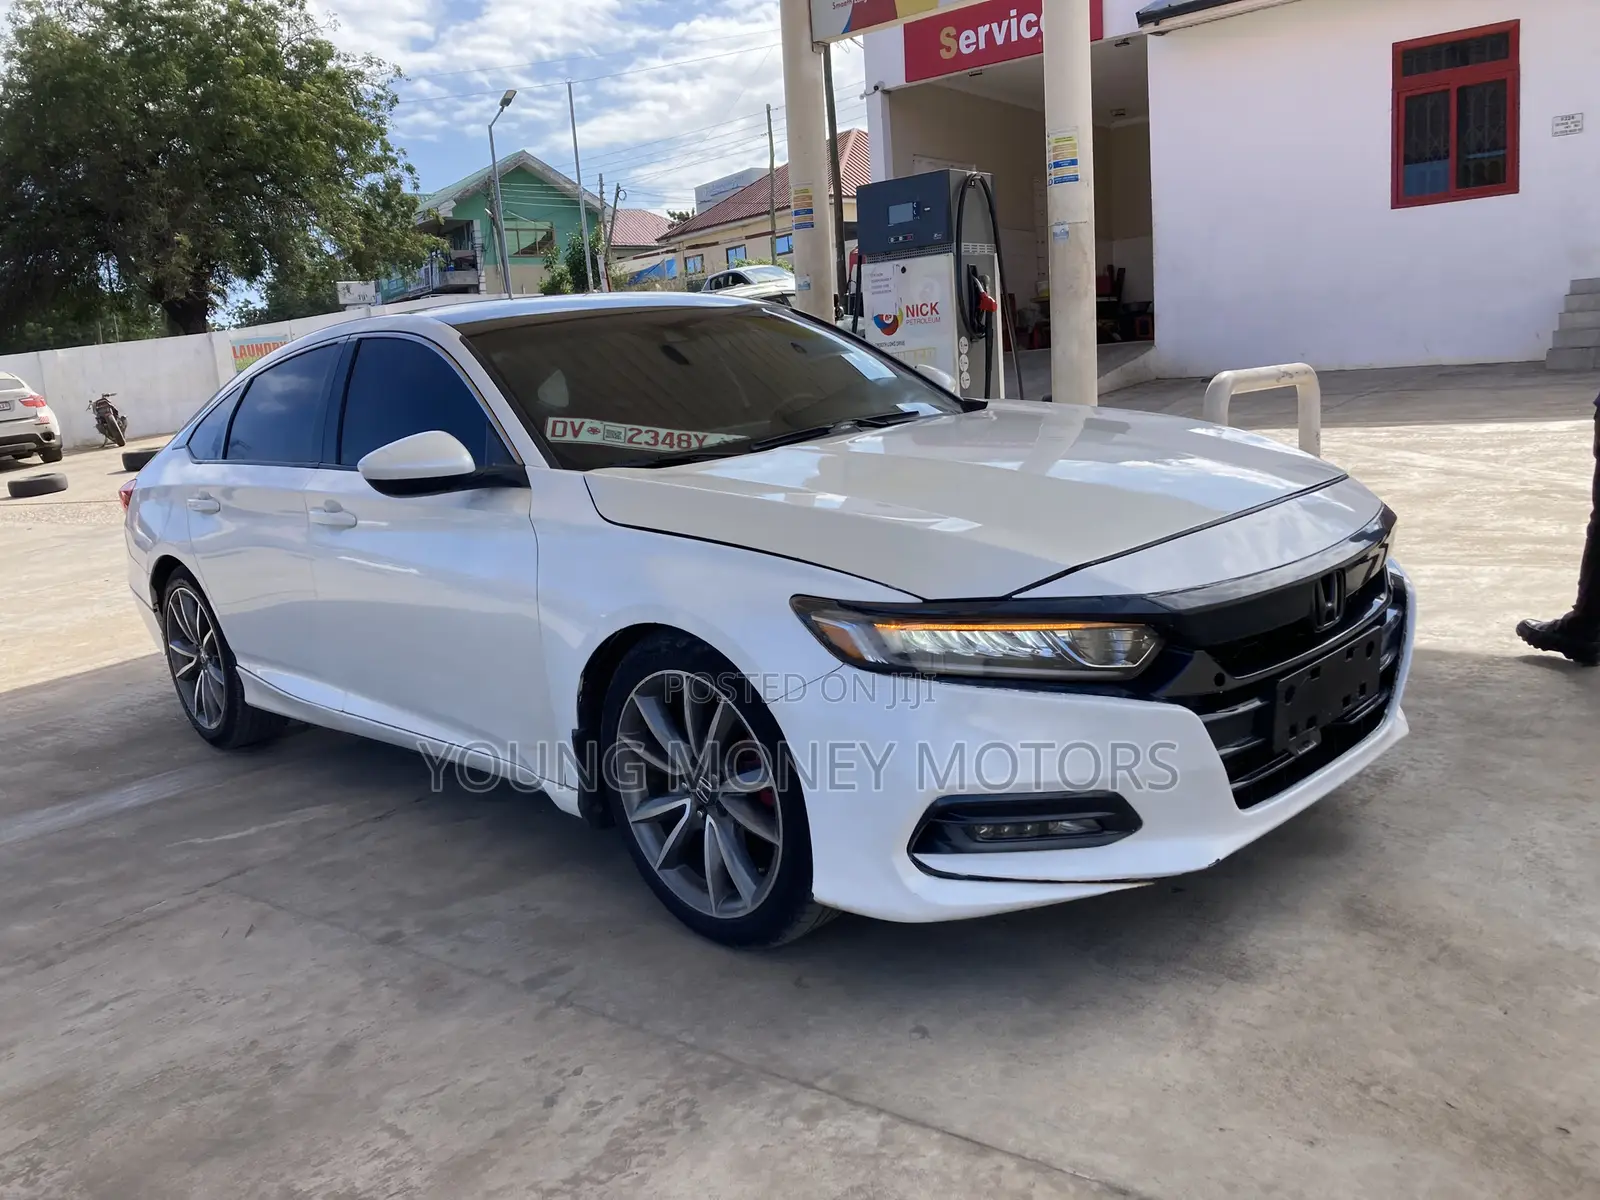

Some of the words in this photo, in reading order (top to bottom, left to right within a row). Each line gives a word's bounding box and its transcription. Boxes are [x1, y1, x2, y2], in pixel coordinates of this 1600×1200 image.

[905, 302, 940, 318] NICK
[906, 317, 941, 325] PETROLEUM
[551, 420, 585, 438] DV
[627, 427, 708, 449] 2348Y
